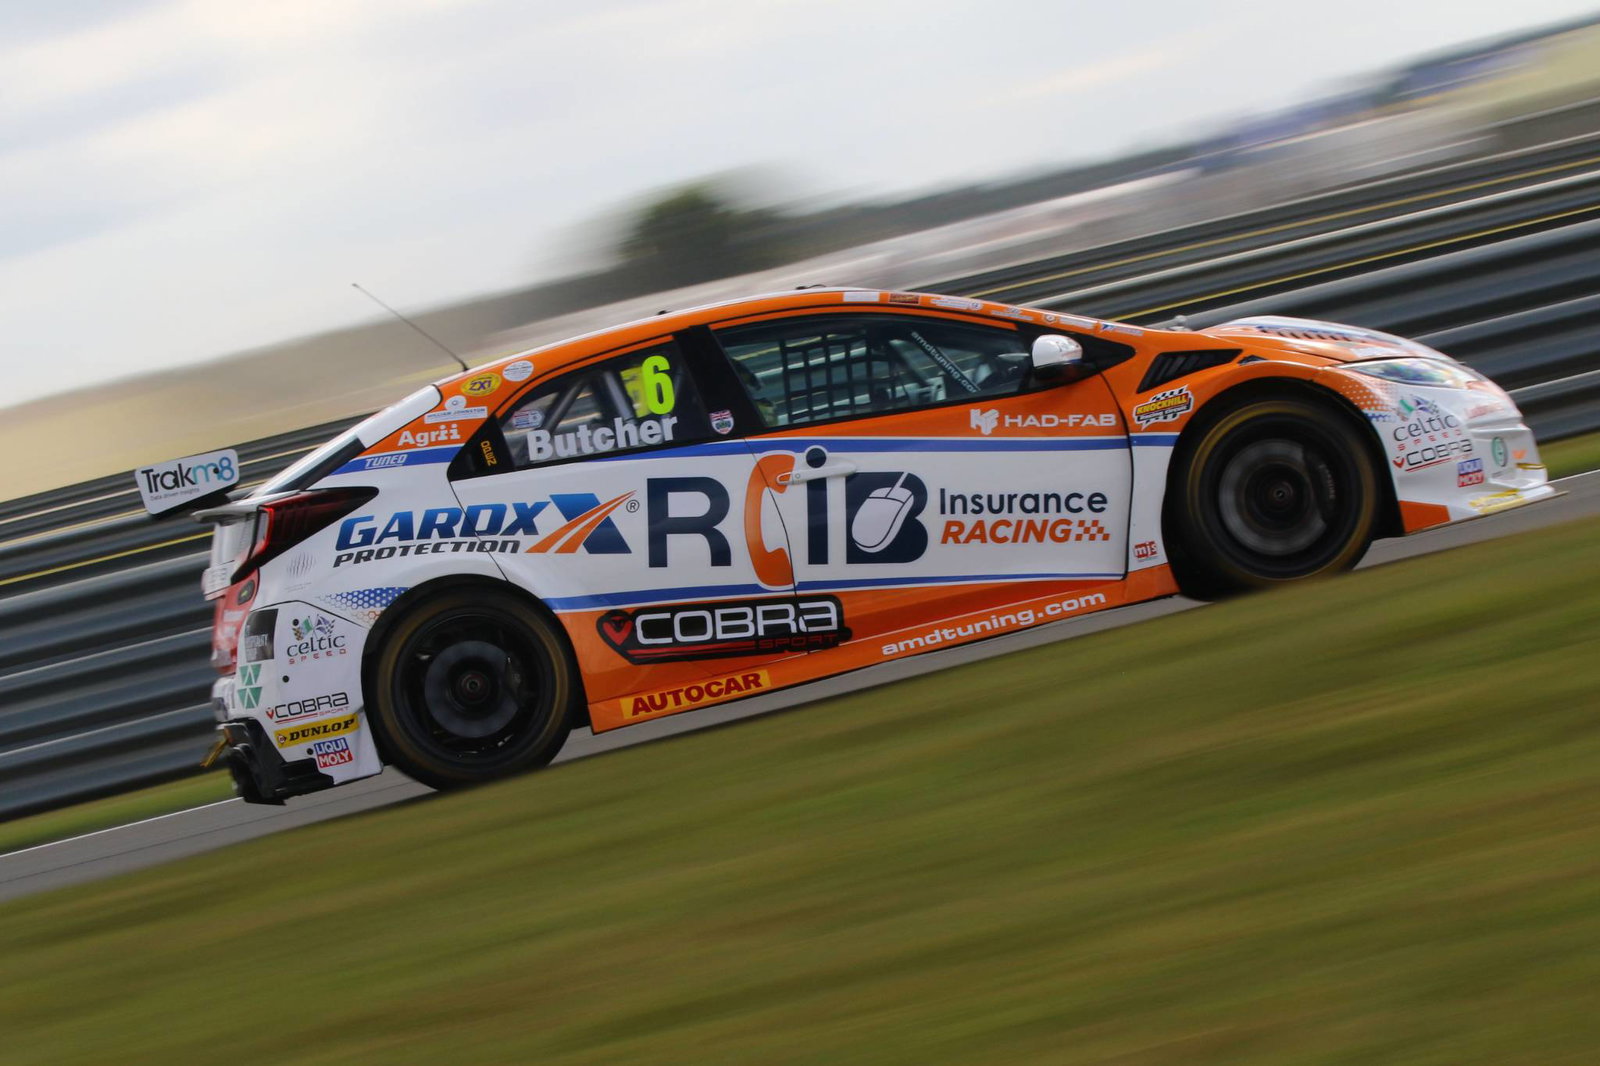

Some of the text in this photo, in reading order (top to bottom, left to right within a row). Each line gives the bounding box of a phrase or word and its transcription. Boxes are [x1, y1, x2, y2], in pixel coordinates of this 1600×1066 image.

[642, 355, 675, 415] 6
[1136, 394, 1188, 416] KNOCKHILL
[1004, 413, 1116, 427] HAD-FAB
[397, 424, 460, 447] Agrii
[527, 416, 678, 461] Butcher
[141, 457, 235, 493] Trakm8
[939, 487, 1108, 515] Insurance
[941, 518, 1073, 544] RACING
[333, 540, 520, 568] PROTECTION
[882, 592, 1107, 656] amdtuning.com
[631, 672, 764, 716] AUTOCAR
[289, 718, 355, 742] DUNLOP
[315, 738, 348, 754] LIQUI
[319, 750, 352, 767] MOLY
